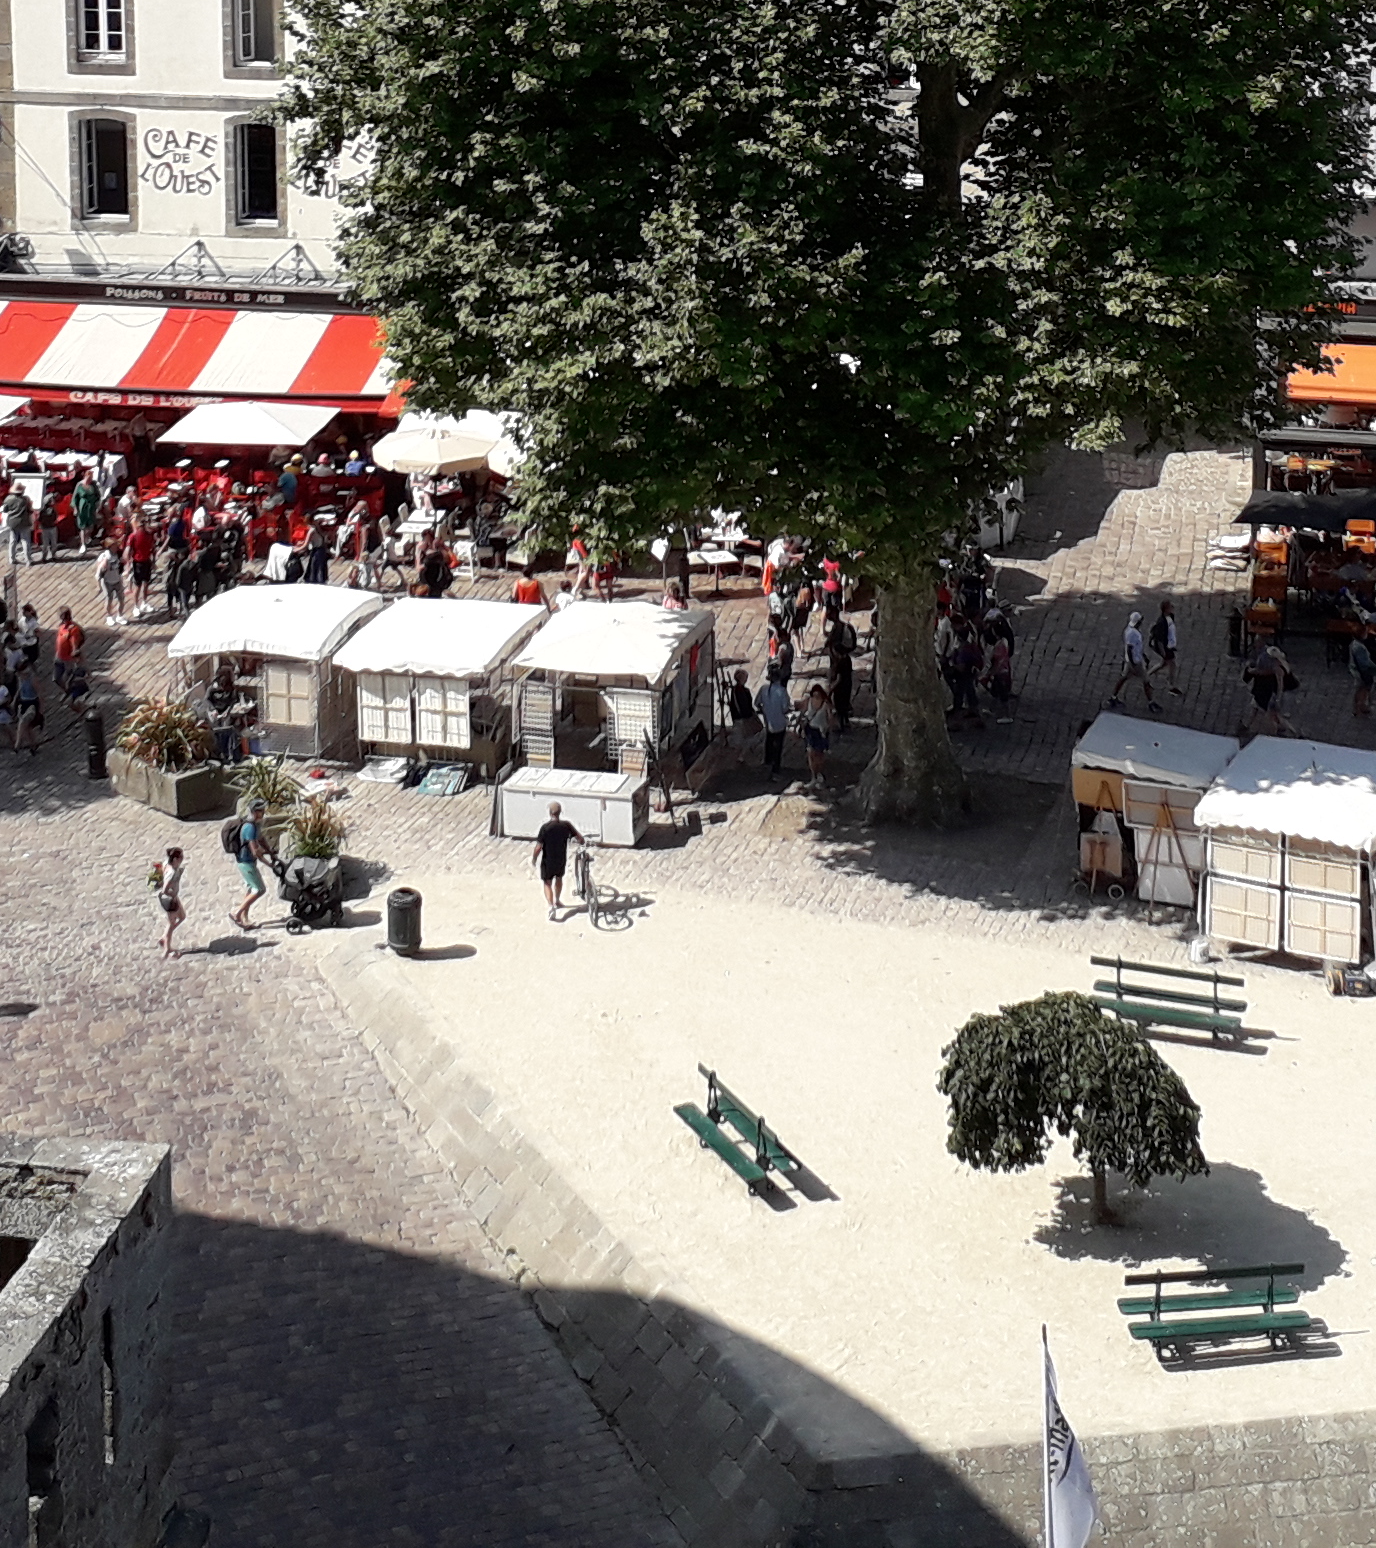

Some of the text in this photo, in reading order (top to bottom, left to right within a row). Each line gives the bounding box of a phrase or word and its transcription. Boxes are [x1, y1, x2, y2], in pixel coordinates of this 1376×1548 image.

[143, 128, 219, 160] CAFÉ
[173, 152, 191, 165] DE
[139, 161, 222, 197] L'OUEST
[234, 294, 251, 302] DE
[256, 294, 285, 304] MER
